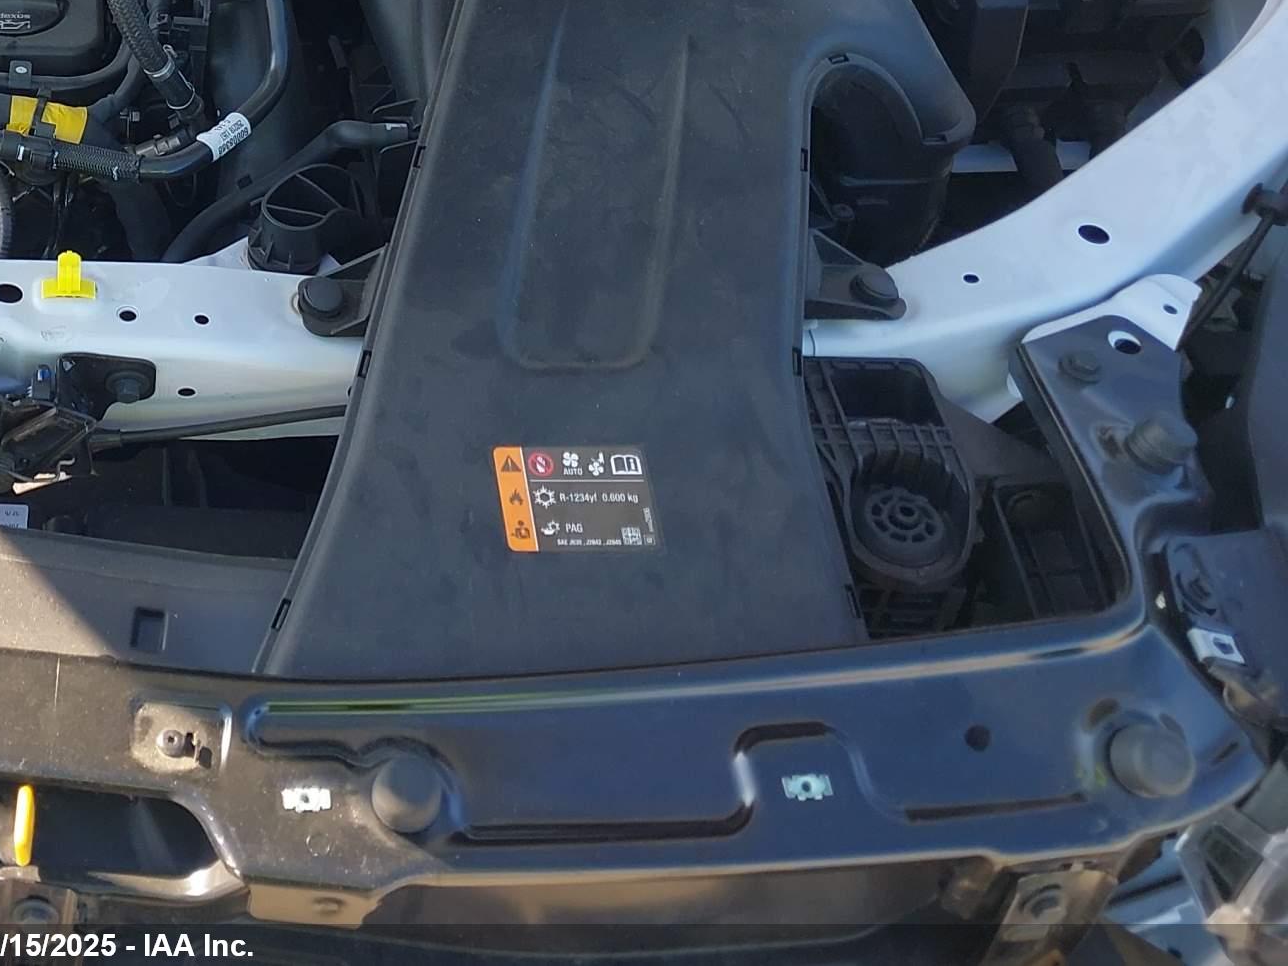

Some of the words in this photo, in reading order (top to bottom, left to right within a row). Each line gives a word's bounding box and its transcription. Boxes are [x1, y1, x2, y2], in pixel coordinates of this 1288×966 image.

[559, 491, 598, 503] R-1234yf
[601, 492, 626, 502] 0.600
[627, 493, 639, 504] kg
[565, 522, 584, 533] PAG
